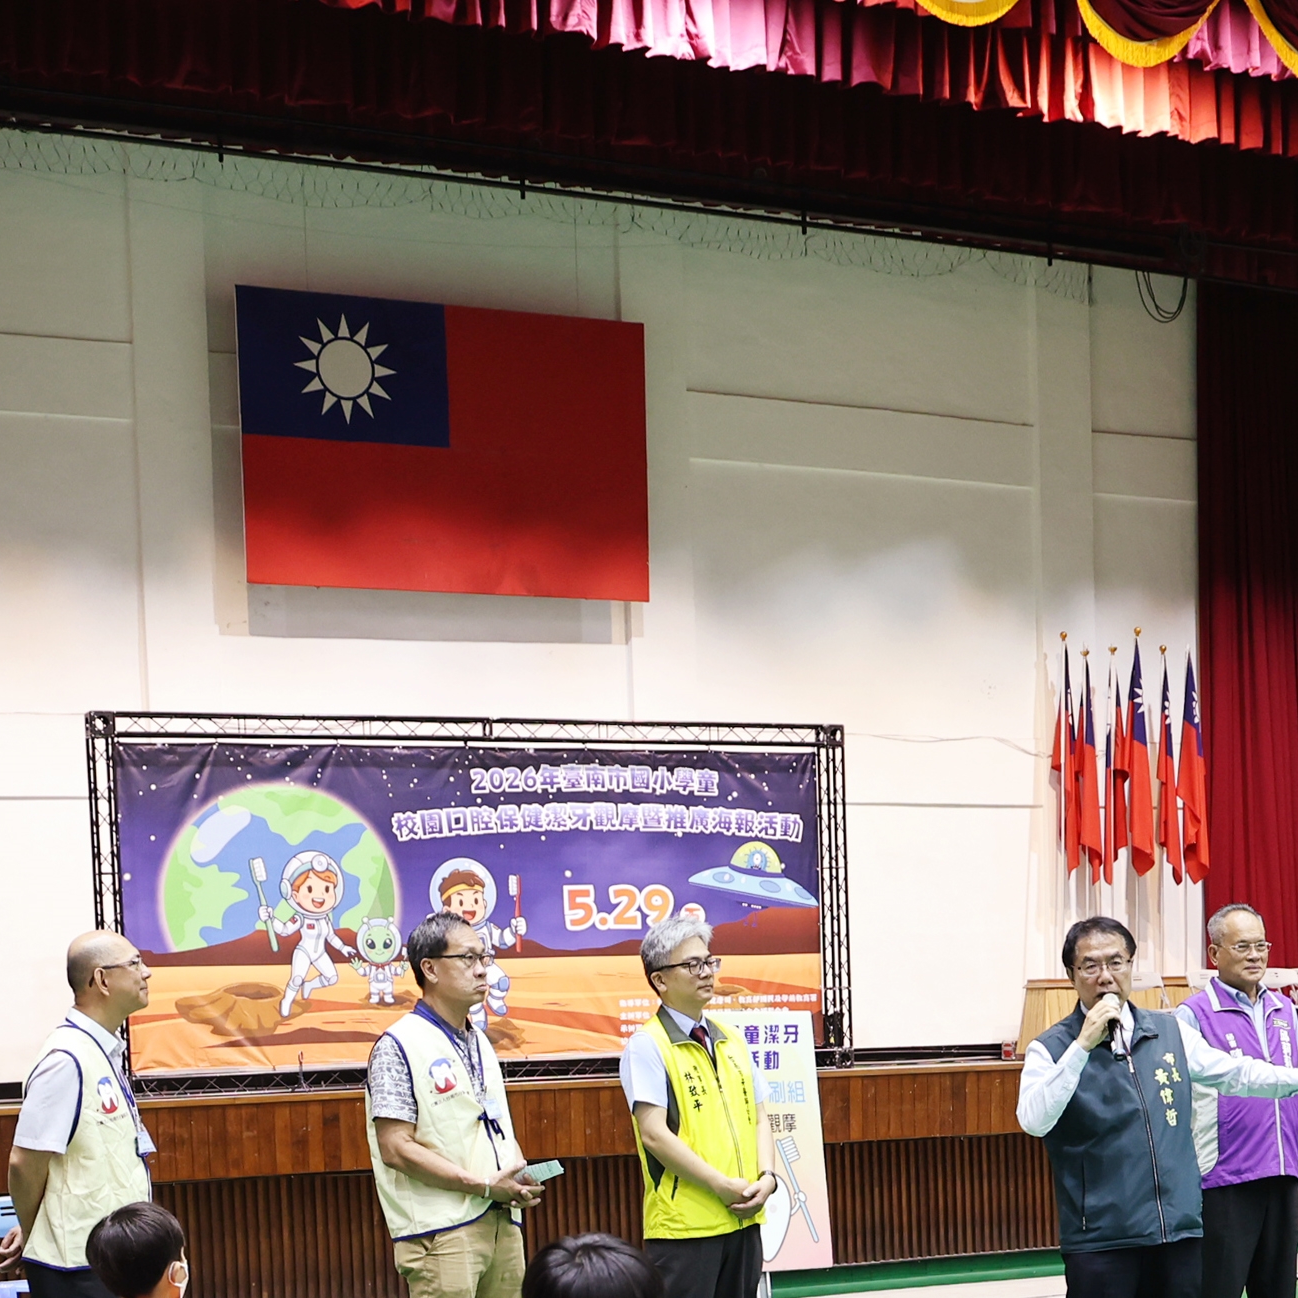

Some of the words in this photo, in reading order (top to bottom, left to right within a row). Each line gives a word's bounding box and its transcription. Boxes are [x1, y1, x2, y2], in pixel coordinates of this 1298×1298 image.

[470, 764, 719, 796] 2026年臺南市國小學童
[392, 801, 804, 842] 校園口腔保健潔牙觀摩暨推廣海報活動
[562, 884, 674, 931] 5.29
[735, 1024, 799, 1044] 童潔牙
[1162, 1052, 1182, 1083] 市長
[752, 1080, 805, 1104] 刷組
[1154, 1068, 1178, 1127] 黃偉哲
